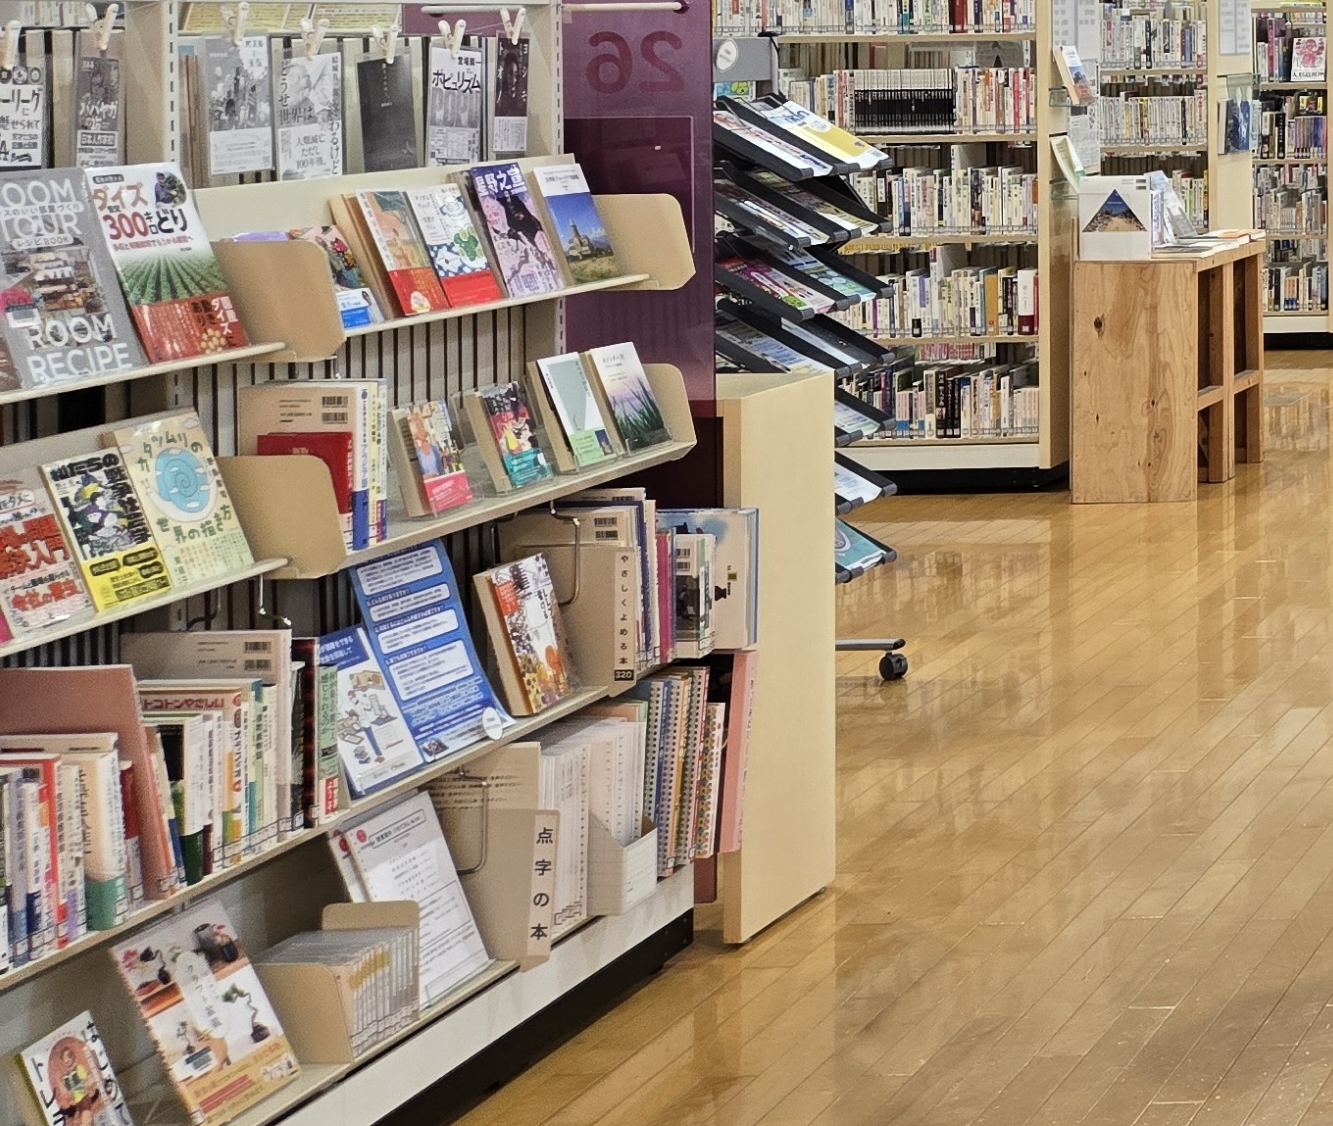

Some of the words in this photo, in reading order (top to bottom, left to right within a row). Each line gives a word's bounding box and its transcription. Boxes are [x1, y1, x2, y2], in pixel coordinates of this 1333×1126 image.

[432, 69, 481, 94] ポピュリズム
[0, 178, 77, 208] OOM
[92, 182, 149, 212] ダイズ
[474, 165, 526, 196] 星野之宣
[27, 314, 118, 351] ROOM
[27, 343, 133, 383] RECIPE
[137, 430, 204, 473] カタツムリの
[156, 503, 233, 545] 世界の描き方
[619, 554, 631, 665] やさしくよめる本
[615, 670, 633, 679] 320
[142, 696, 225, 710] トコトンやさしい
[530, 827, 555, 942] 点字の本
